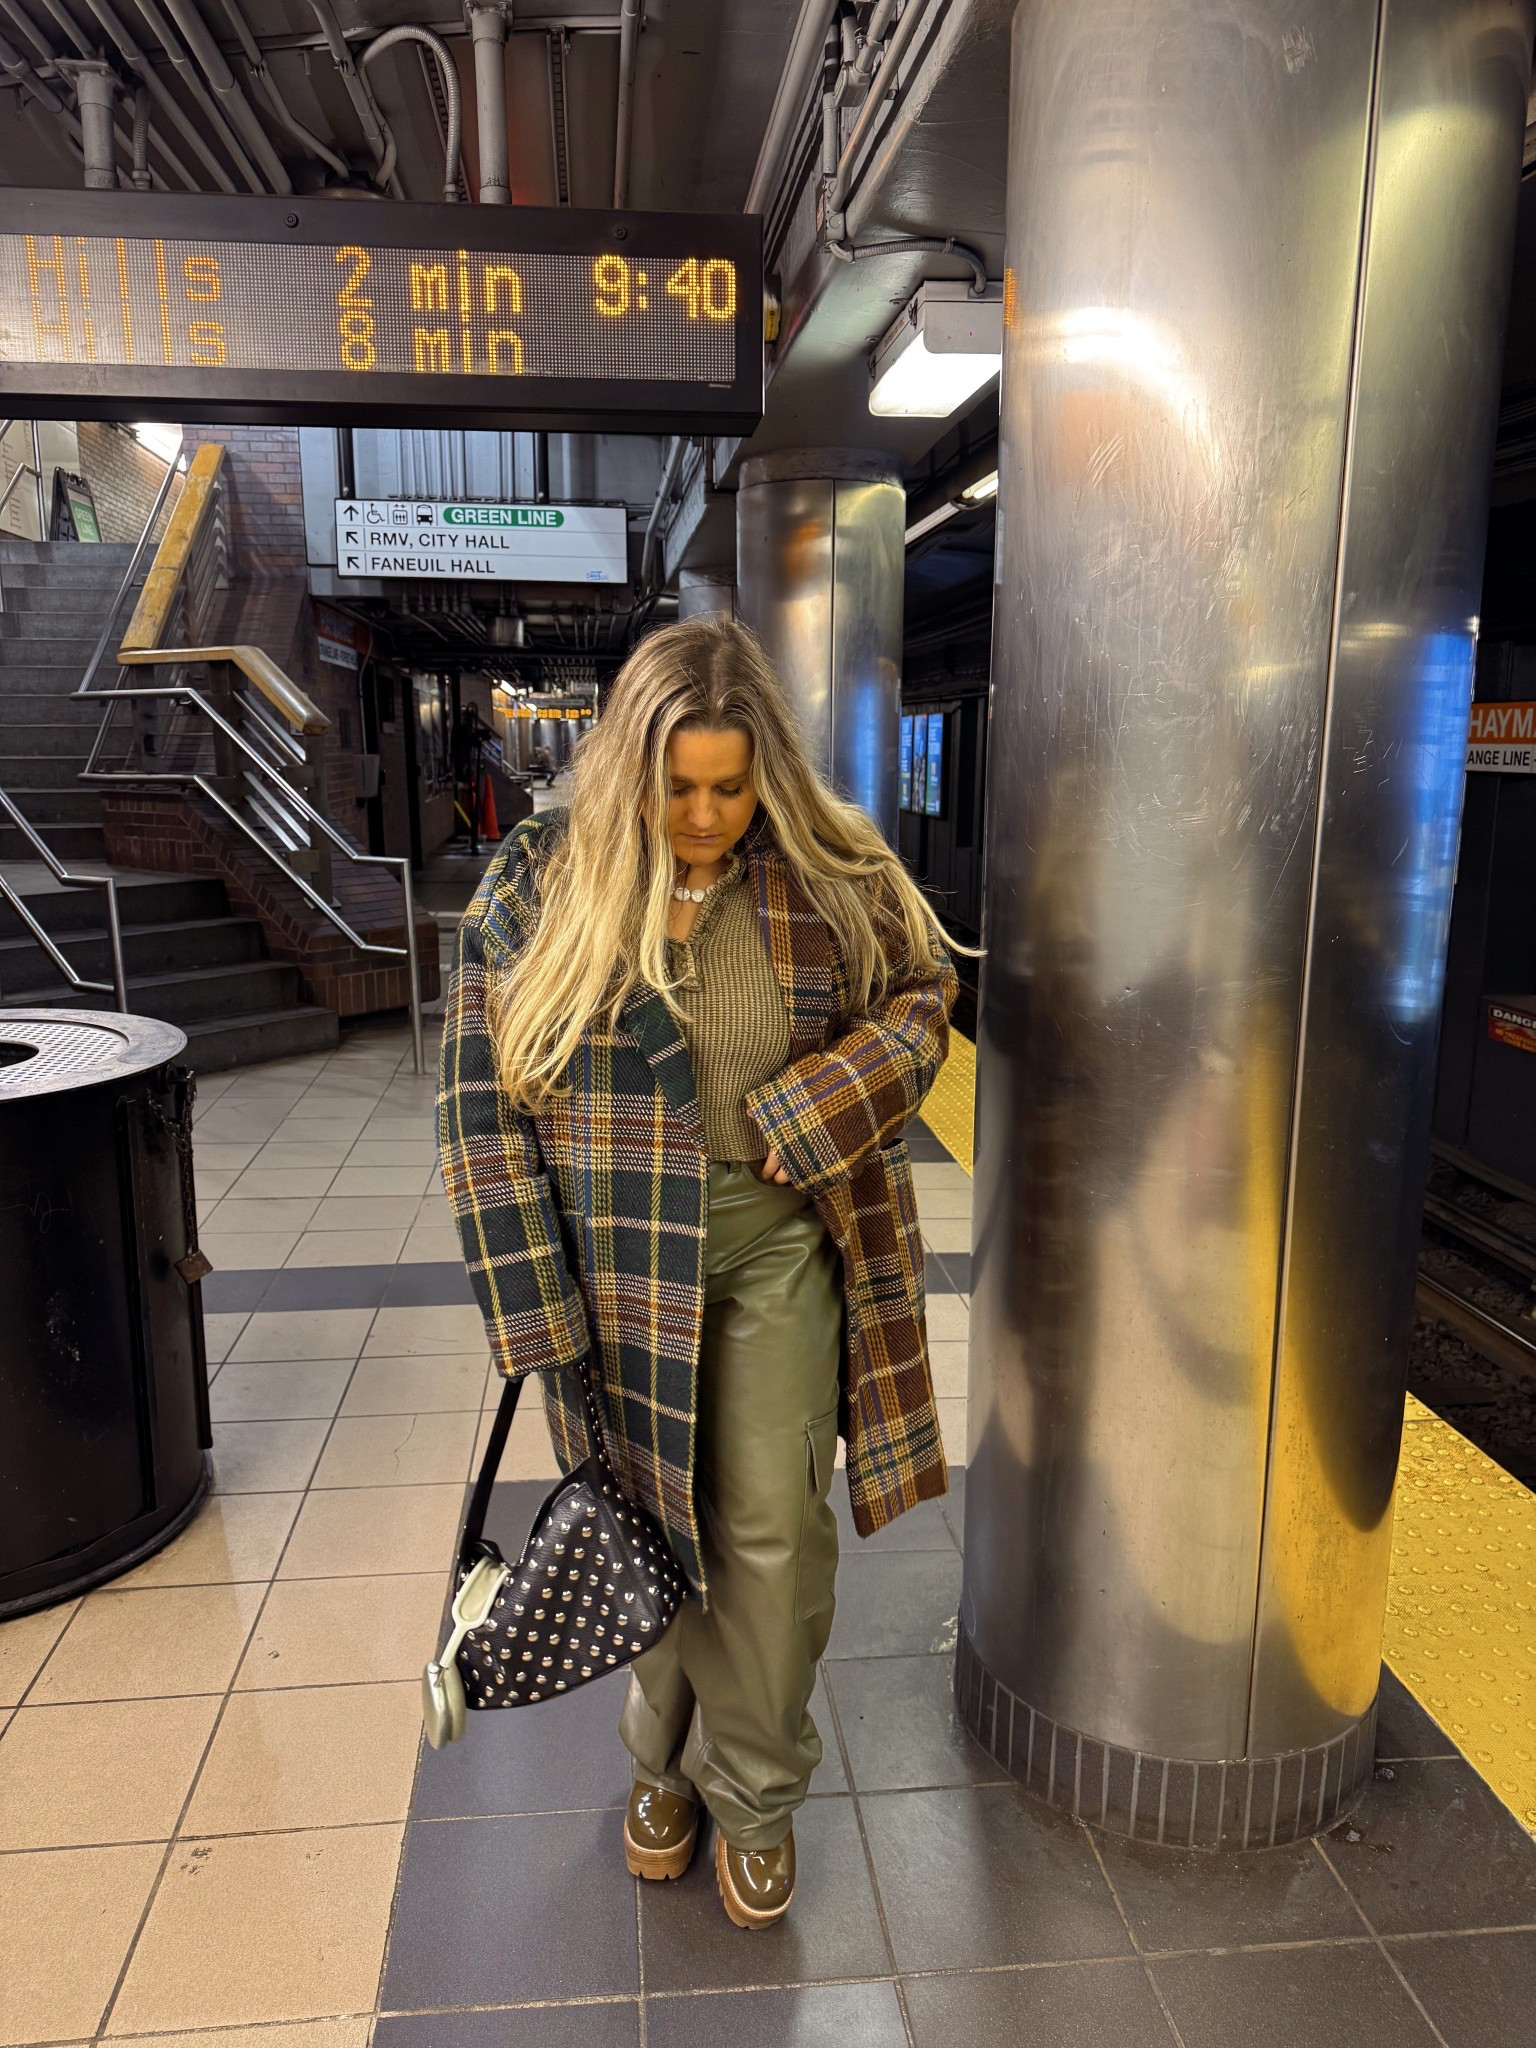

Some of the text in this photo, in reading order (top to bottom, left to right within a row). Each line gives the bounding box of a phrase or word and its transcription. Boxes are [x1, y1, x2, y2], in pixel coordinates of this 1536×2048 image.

[25, 234, 736, 320] Hills 2 min 9:40
[32, 301, 524, 374] Hills 8 min
[451, 508, 557, 526] GREEN LINE
[370, 532, 510, 549] RMV, CITY HALL
[371, 557, 495, 573] FANEUIL HALL
[1468, 708, 1536, 738] HAYM
[1503, 750, 1531, 766] LINE
